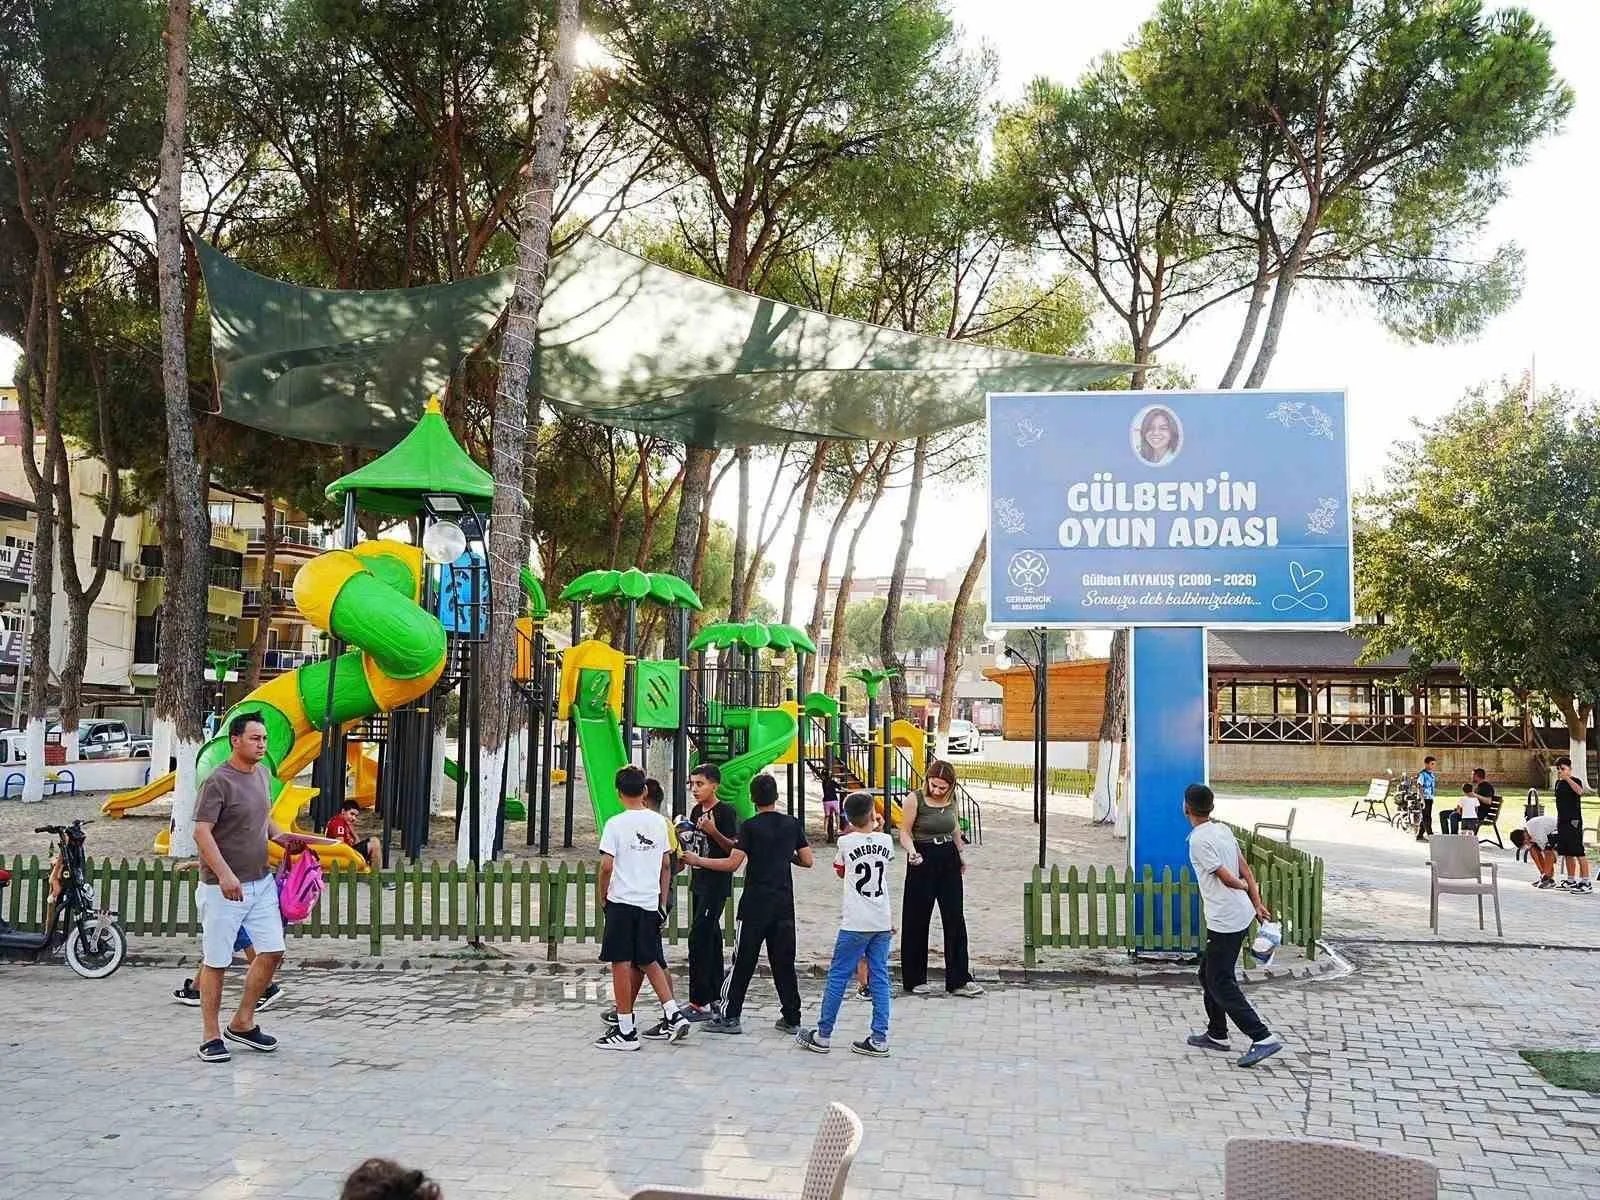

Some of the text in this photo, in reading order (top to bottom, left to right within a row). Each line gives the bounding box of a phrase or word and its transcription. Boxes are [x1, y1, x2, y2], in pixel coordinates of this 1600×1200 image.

[1058, 516, 1279, 548] OYUN ADASI
[1123, 573, 1175, 588] KAYAKUŞ
[1139, 591, 1164, 606] dek
[855, 861, 884, 897] 21
